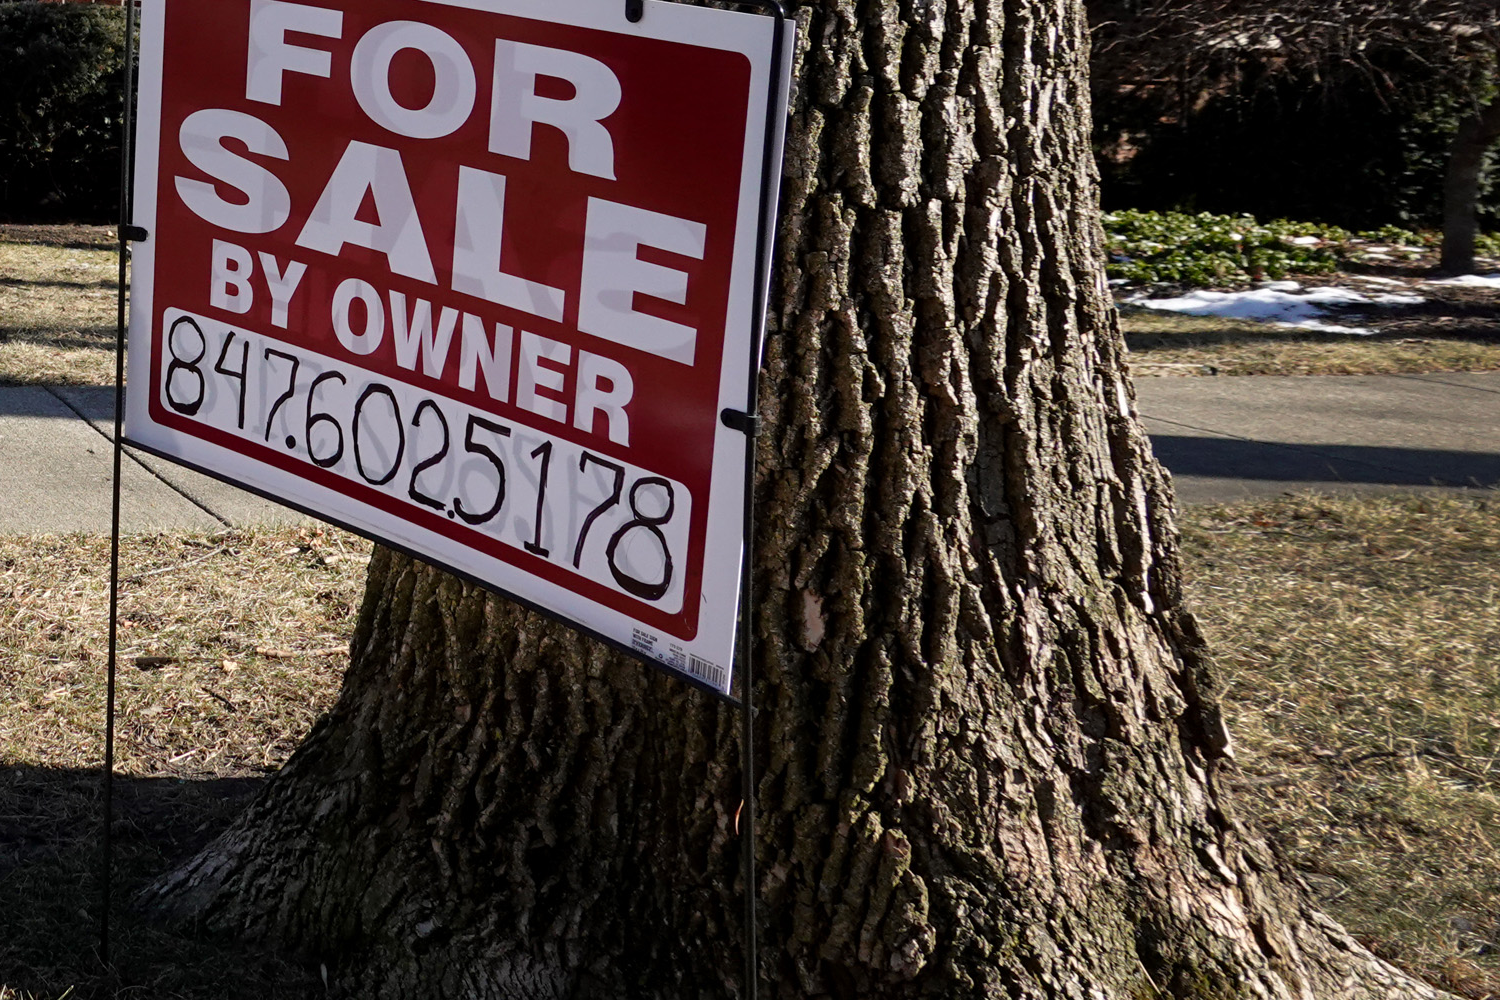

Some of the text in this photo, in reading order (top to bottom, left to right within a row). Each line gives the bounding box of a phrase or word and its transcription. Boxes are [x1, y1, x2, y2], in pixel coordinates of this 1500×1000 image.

[174, 109, 707, 366] SALE
[210, 239, 634, 448] BY OWNER
[165, 315, 675, 601] 847.602.5178
